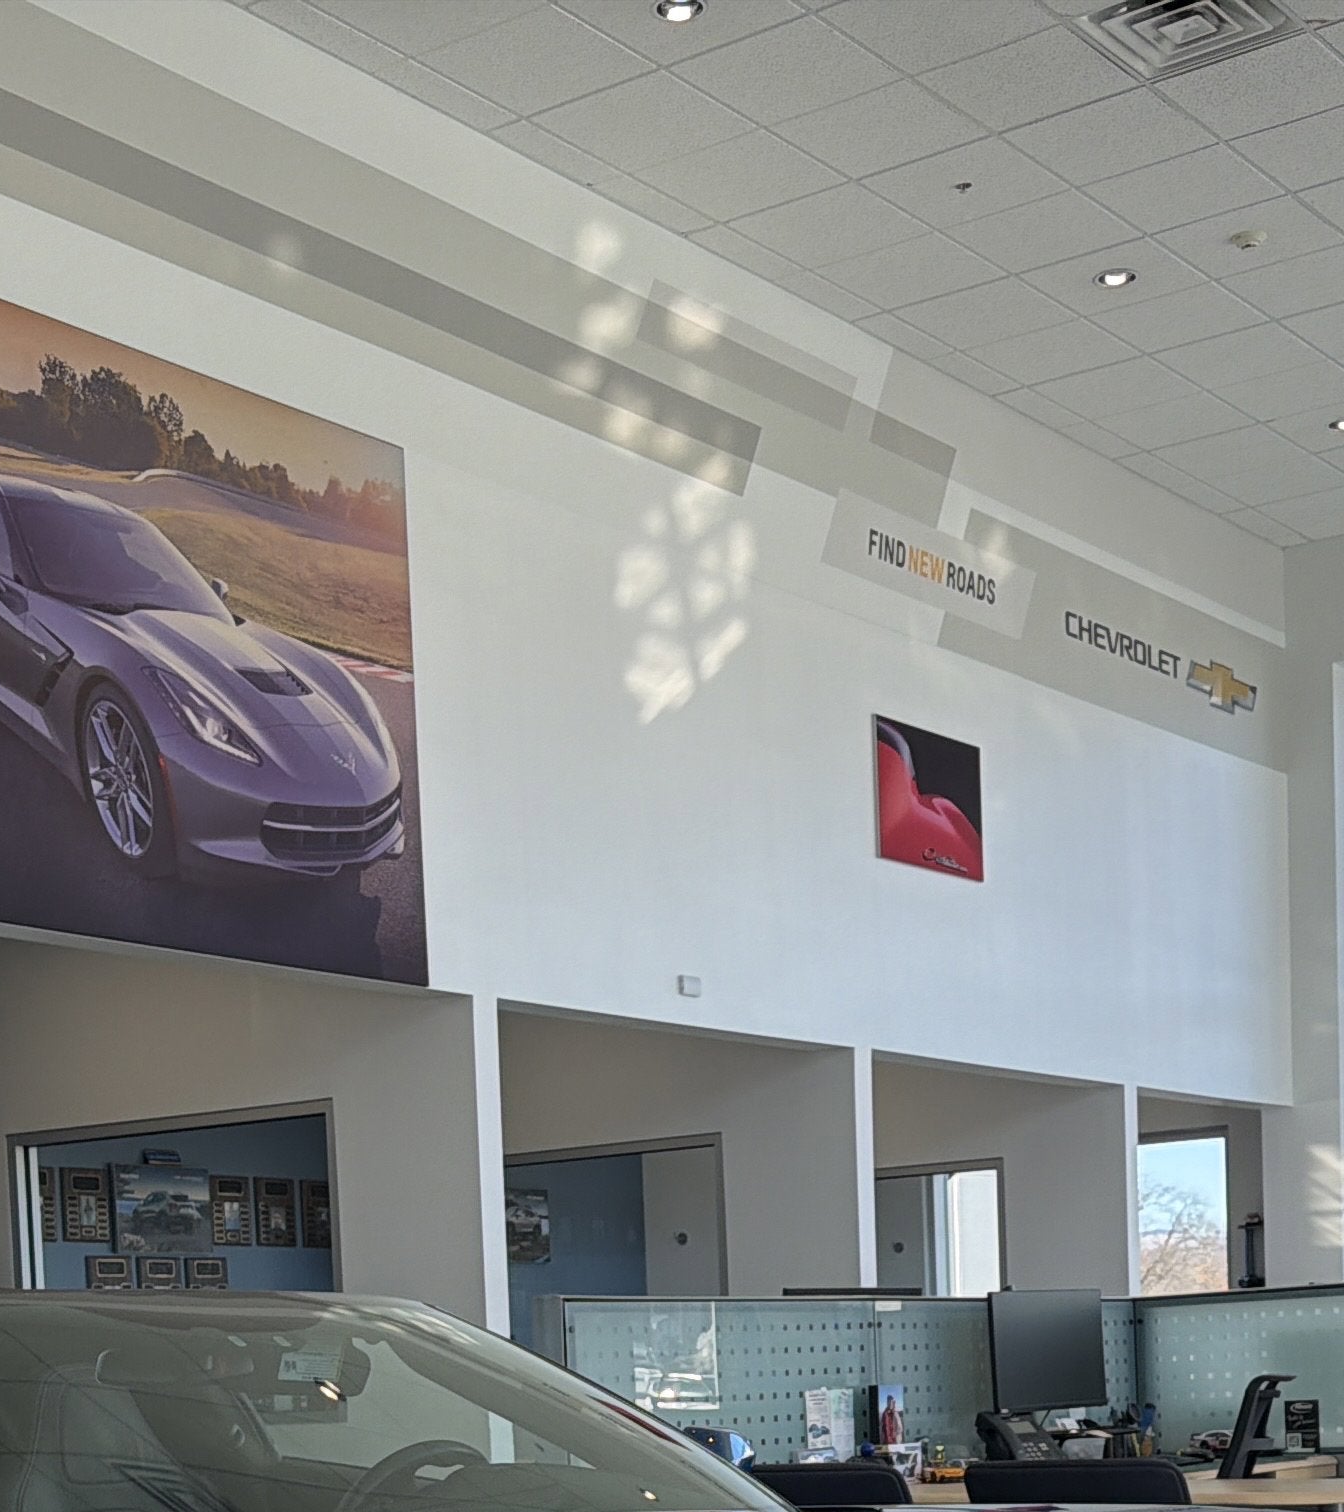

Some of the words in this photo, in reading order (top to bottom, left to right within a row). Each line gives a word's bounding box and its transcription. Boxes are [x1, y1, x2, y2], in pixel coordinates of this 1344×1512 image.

[868, 528, 905, 568] FIND
[907, 545, 945, 584] NEW
[946, 561, 996, 605] ROADS
[1065, 610, 1181, 679] CHEVROLET
